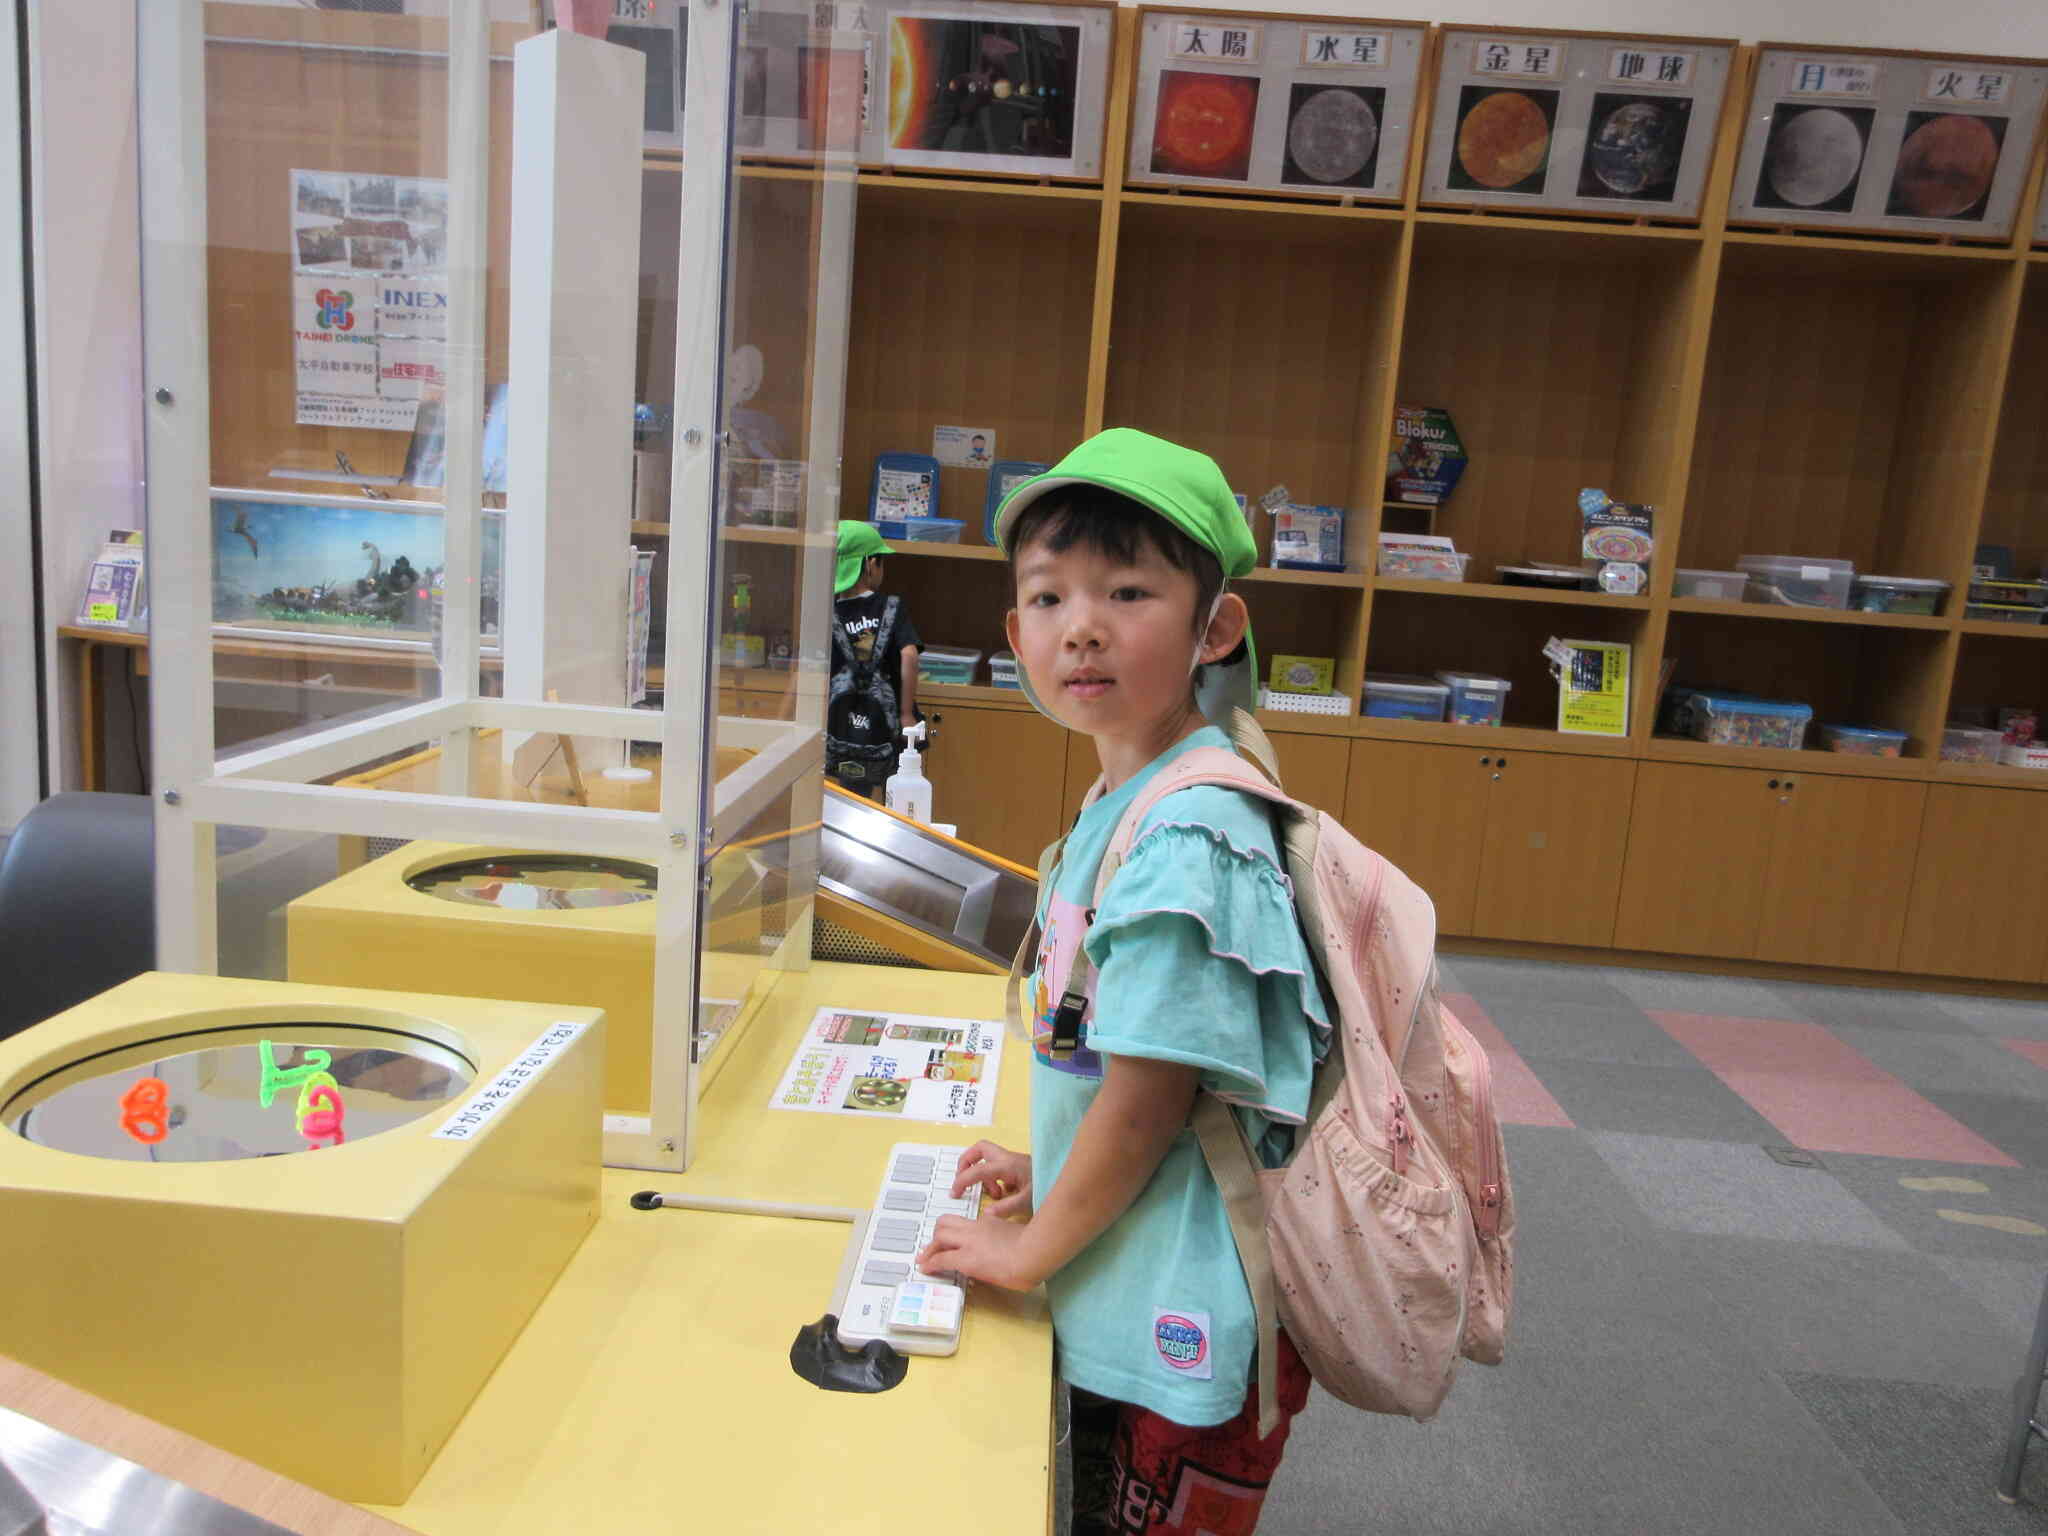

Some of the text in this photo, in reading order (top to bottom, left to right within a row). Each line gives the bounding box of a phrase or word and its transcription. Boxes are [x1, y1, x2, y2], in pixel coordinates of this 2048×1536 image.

[1183, 28, 1248, 57] 太陽
[1312, 35, 1378, 63] 水星
[1484, 44, 1549, 73] 金星
[1616, 52, 1684, 82] 地球
[1799, 63, 1825, 91] 月
[1935, 71, 2002, 100] 火星
[1396, 418, 1448, 440] Blokus
